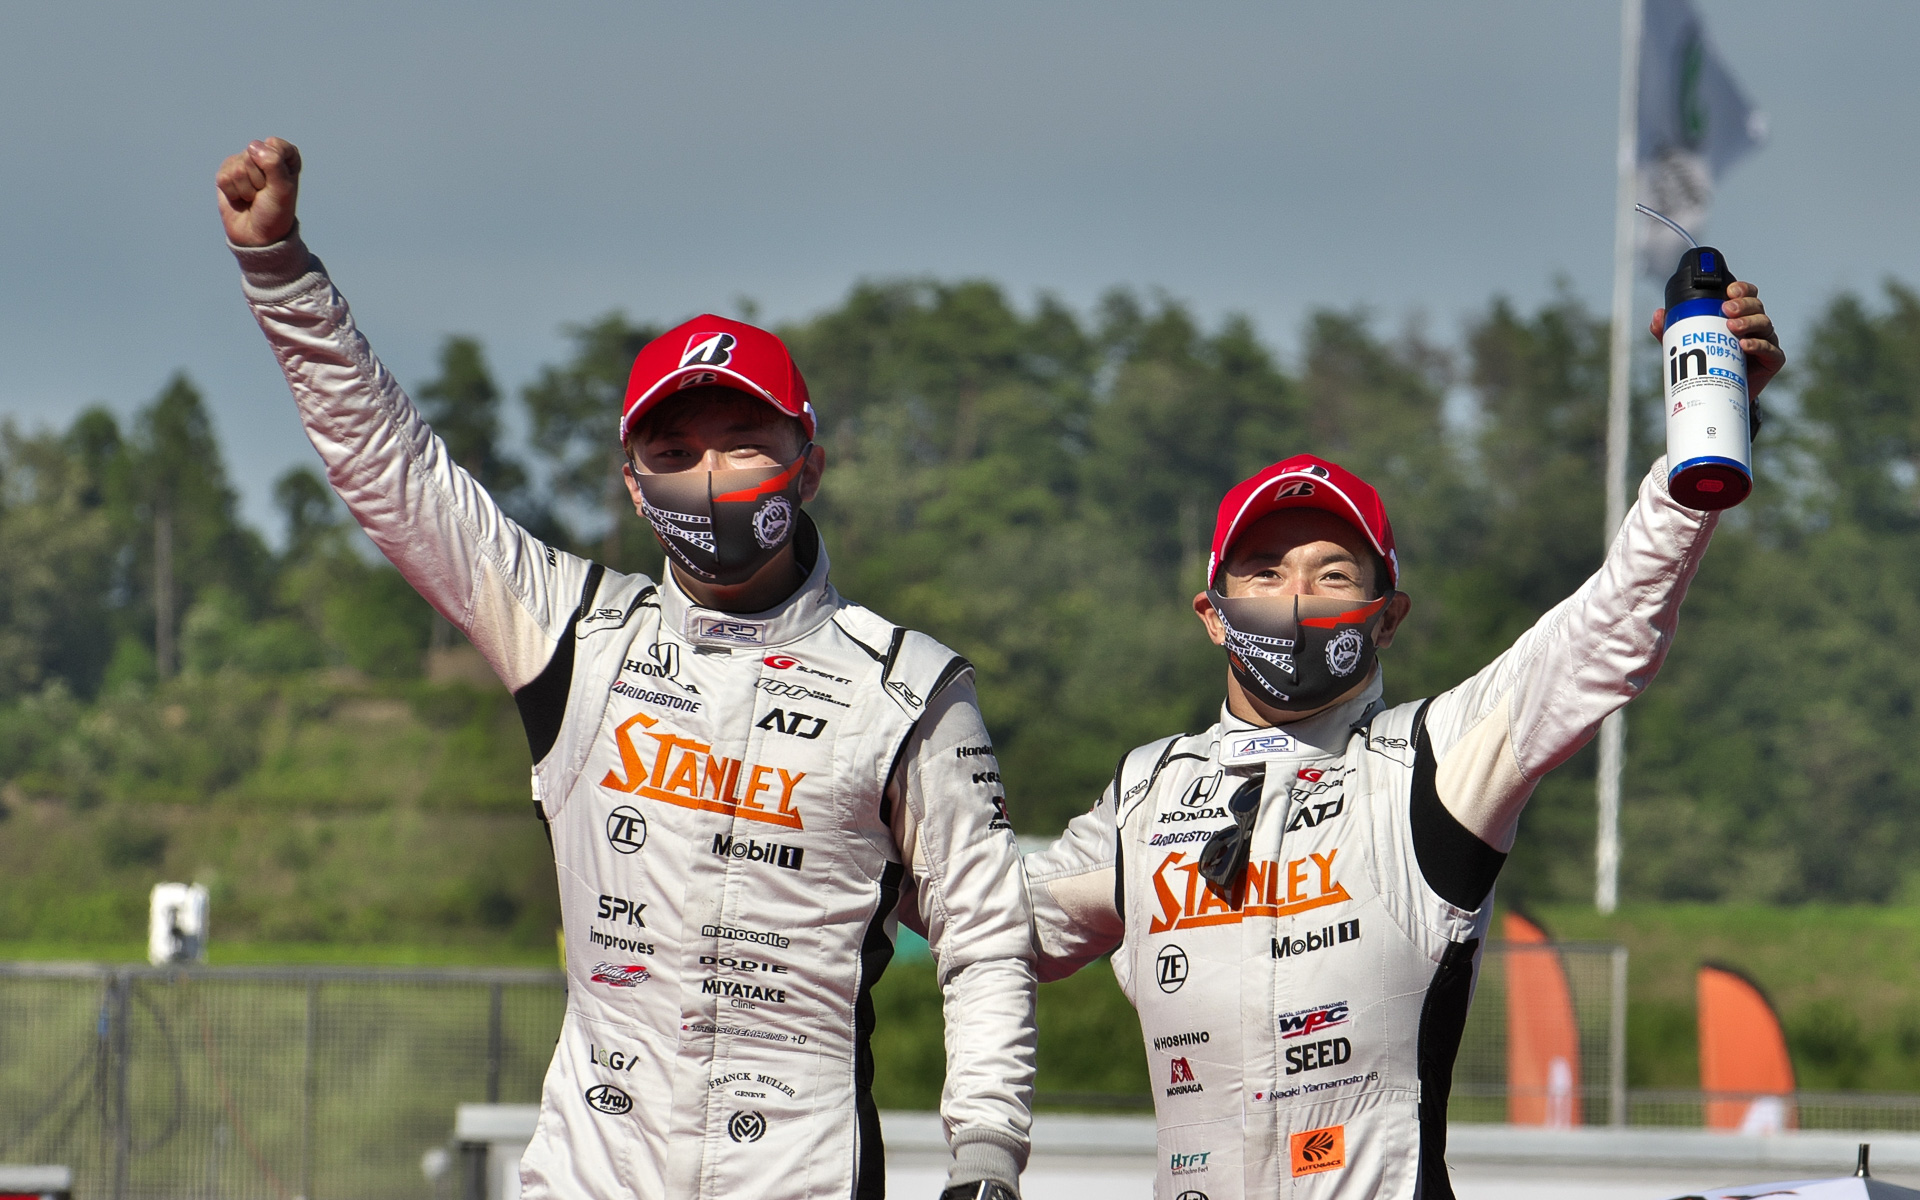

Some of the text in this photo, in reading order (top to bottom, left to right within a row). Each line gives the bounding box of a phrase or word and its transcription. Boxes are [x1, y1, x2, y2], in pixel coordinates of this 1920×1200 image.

[1670, 346, 1707, 387] in
[624, 659, 701, 695] HONA
[612, 680, 702, 713] BRIDGESTONE
[1240, 737, 1289, 752] ARD
[600, 712, 807, 830] STANLEY
[609, 812, 646, 848] ZF
[1158, 807, 1228, 824] HONDA
[712, 833, 779, 865] Mobil
[598, 895, 648, 928] SPK
[590, 925, 655, 955] improves
[702, 925, 790, 949] monocolle
[1271, 925, 1334, 959] Mobil
[700, 956, 788, 975] DODIE
[1157, 952, 1187, 985] ZF
[702, 980, 786, 1003] MIYATAKE
[1160, 1031, 1210, 1049] HOSHINO
[1285, 1037, 1352, 1075] SEED
[710, 1072, 796, 1098] FRANCK MULLER
[1166, 1083, 1203, 1098] MORINAGA
[1270, 1088, 1301, 1101] Naoki
[1303, 1075, 1364, 1093] Yamamoto
